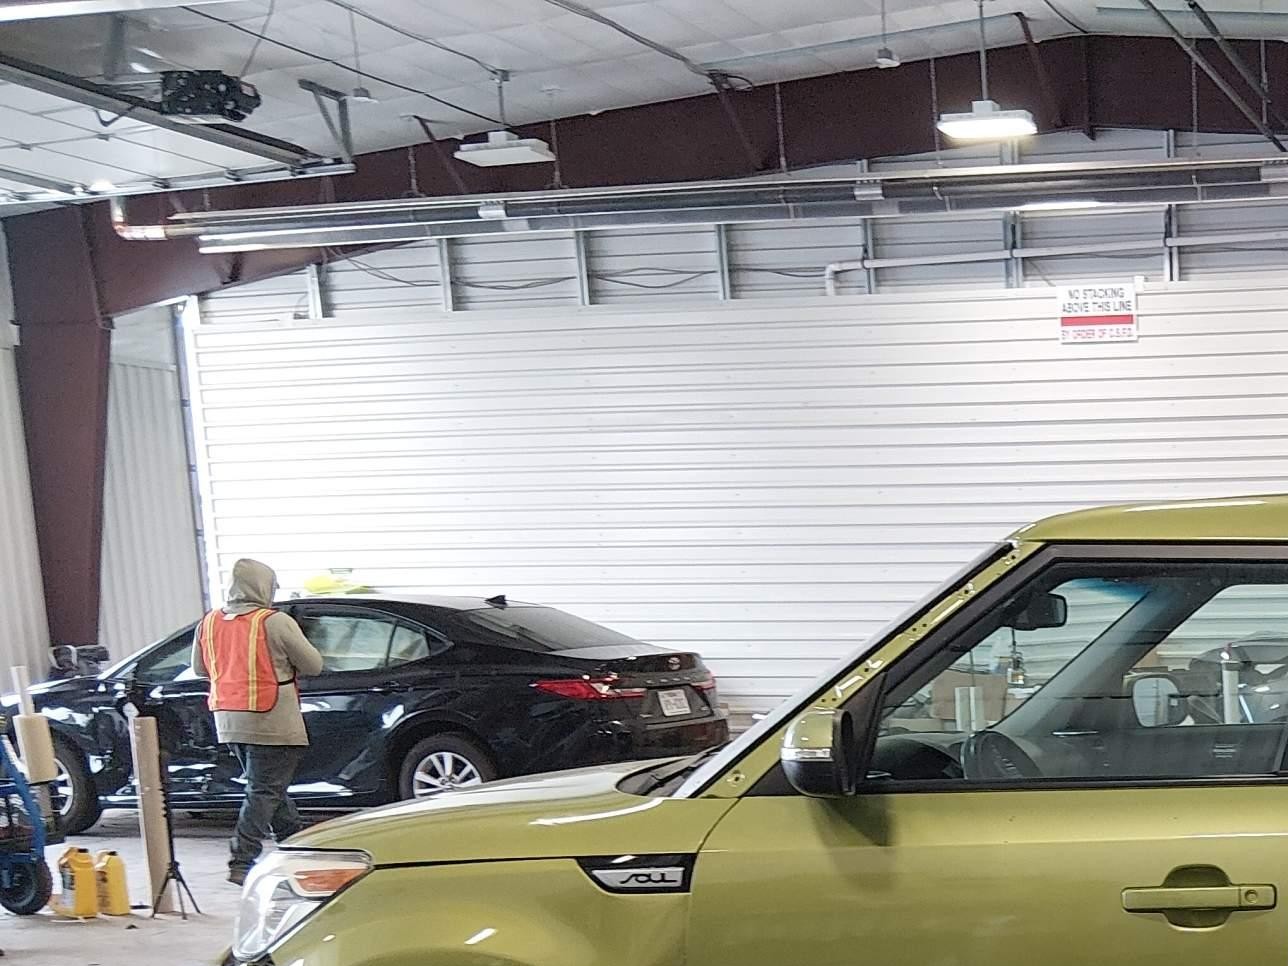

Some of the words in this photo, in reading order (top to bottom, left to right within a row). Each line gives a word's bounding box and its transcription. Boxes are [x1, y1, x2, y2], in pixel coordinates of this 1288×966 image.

[1068, 289, 1080, 300] NO
[1083, 287, 1125, 300] STACKING
[1062, 302, 1089, 313] ABOVE
[1092, 301, 1111, 312] THIS
[1113, 300, 1132, 312] LINE
[1061, 330, 1070, 340] BY
[1072, 328, 1096, 340] ORDER
